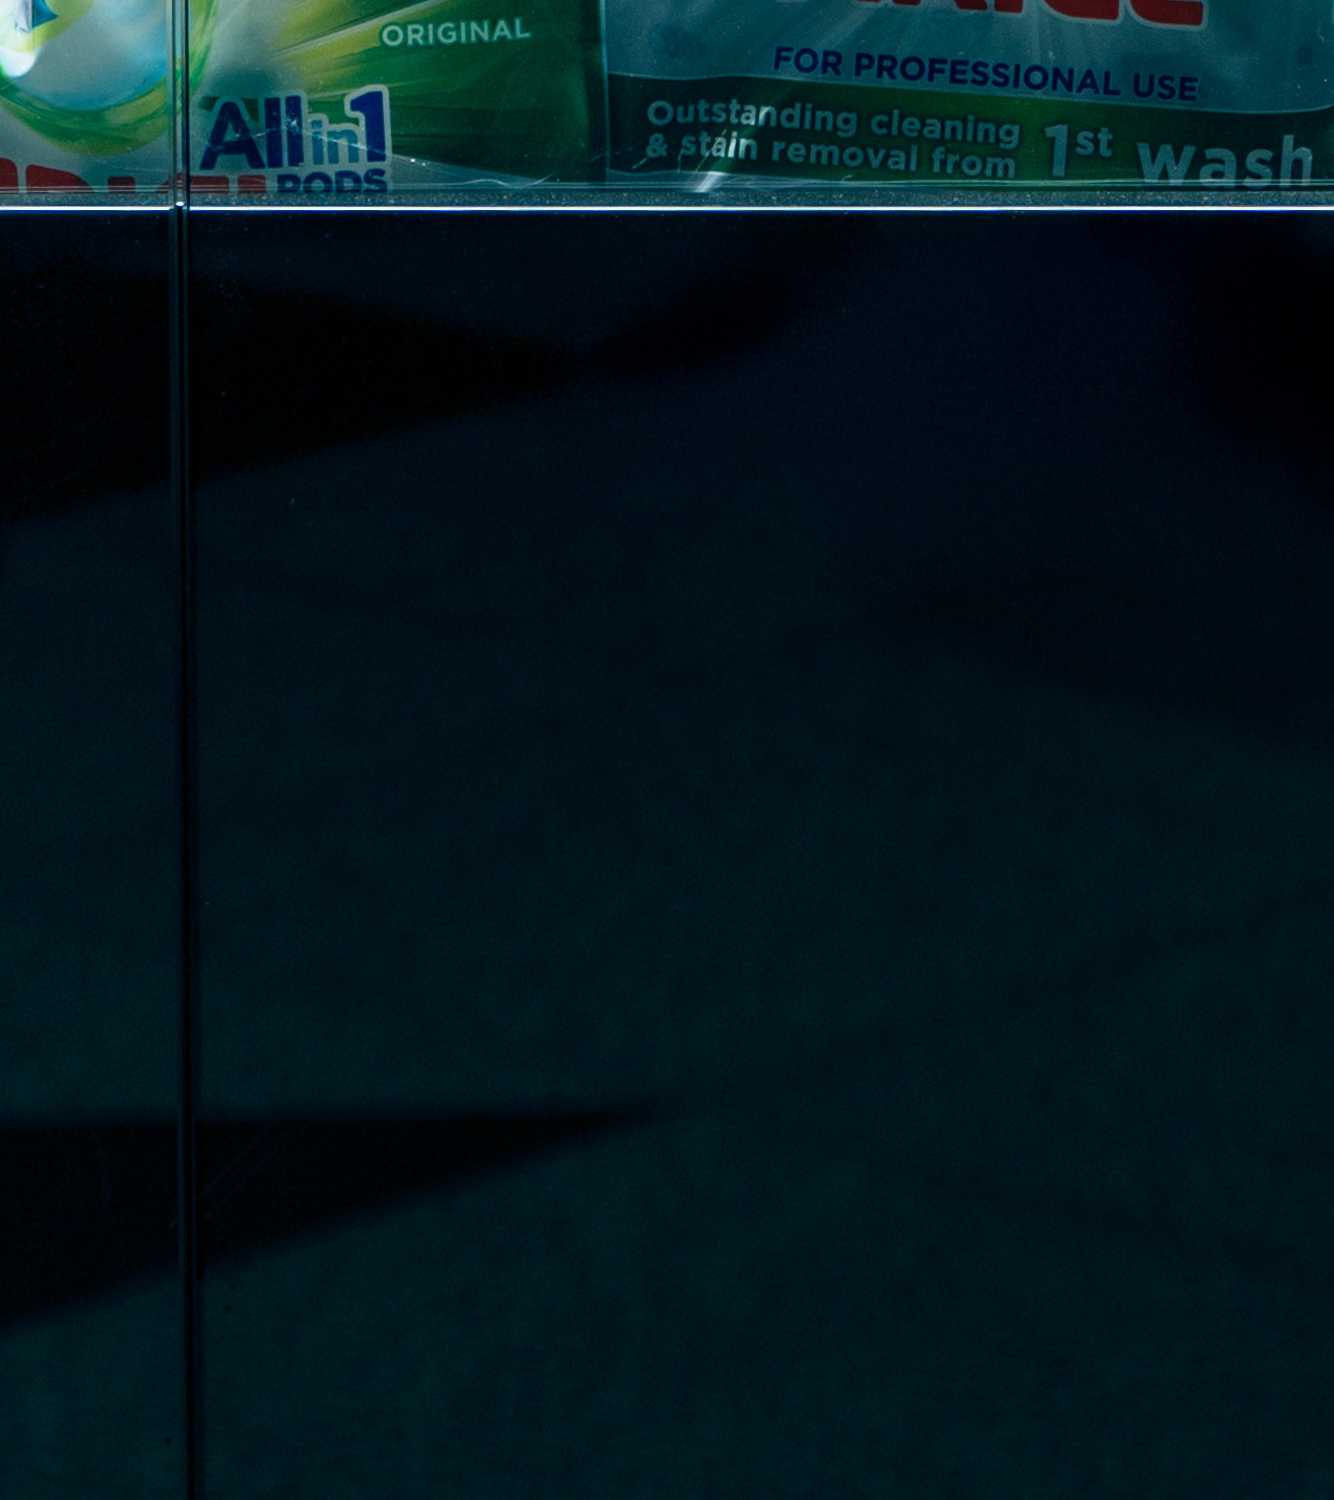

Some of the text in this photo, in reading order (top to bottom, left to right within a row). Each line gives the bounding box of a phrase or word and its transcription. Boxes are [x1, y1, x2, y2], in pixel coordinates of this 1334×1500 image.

[381, 17, 531, 48] ORIGINAL
[774, 46, 1200, 101] FOR PROFESSIONAL USE
[647, 98, 1021, 149] Outstanding cleaning
[645, 130, 1017, 179] & stain removal from
[1044, 123, 1315, 188] 1st wash
